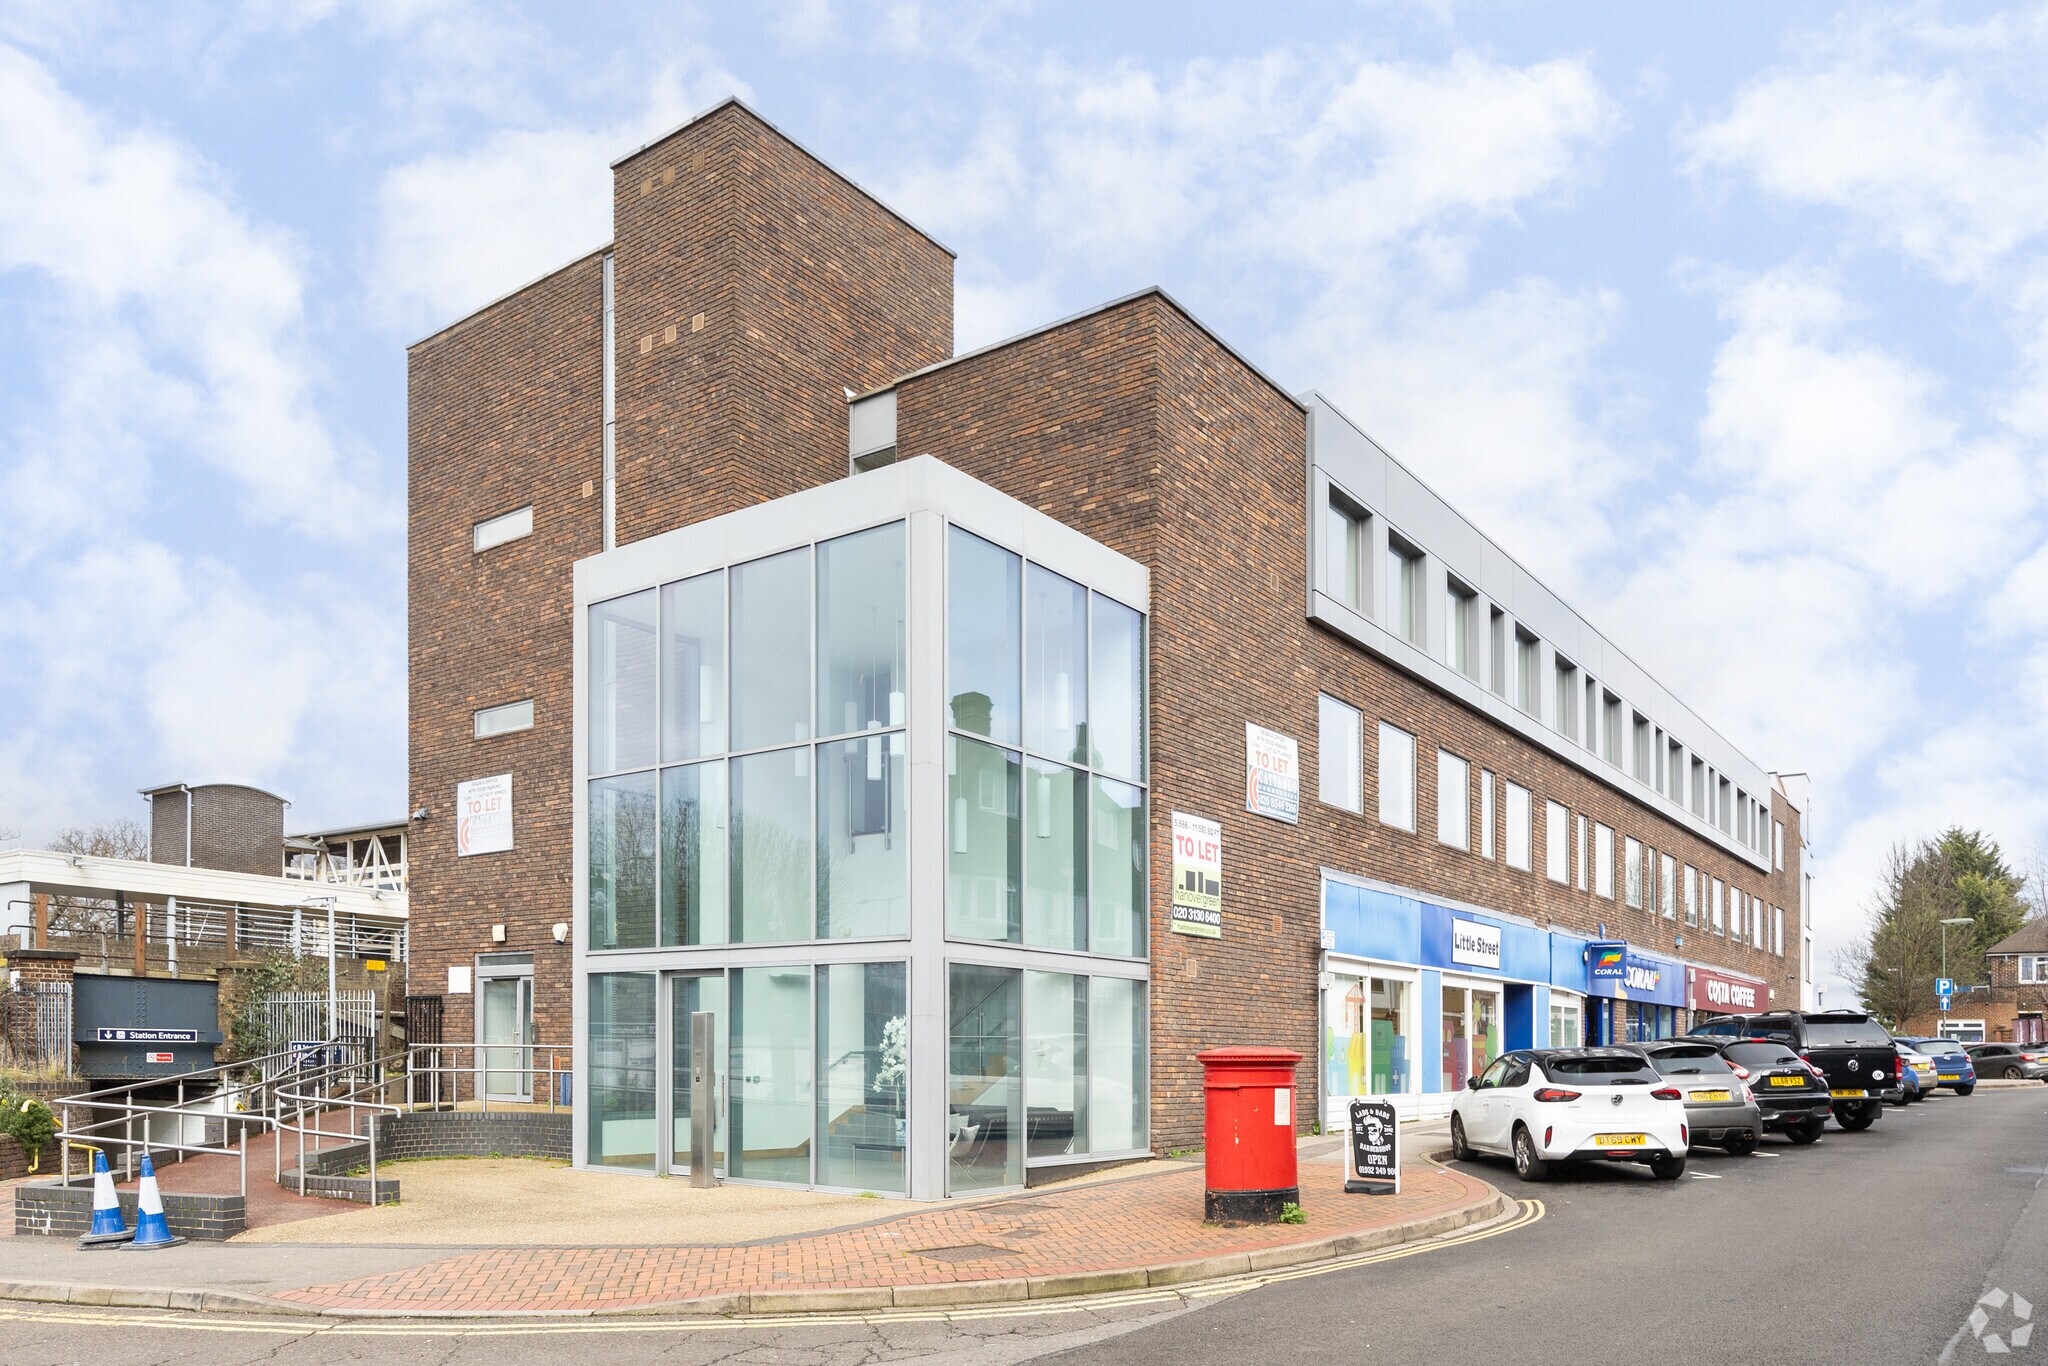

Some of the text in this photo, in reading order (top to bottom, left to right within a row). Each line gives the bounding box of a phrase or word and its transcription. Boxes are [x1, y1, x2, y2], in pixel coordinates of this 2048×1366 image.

[1256, 750, 1289, 774] TO LET
[467, 800, 481, 815] TO
[485, 797, 502, 812] LET
[1176, 834, 1218, 863] TO LET
[1175, 879, 1220, 908] hanovergreen
[1173, 905, 1220, 925] 020 3130 6400
[1454, 932, 1499, 956] Little Street
[1624, 966, 1656, 991] CORAL
[1939, 980, 1950, 994] P
[1707, 979, 1755, 1008] COSTA COFFEE
[129, 1031, 191, 1040] Station Entrance
[1355, 1108, 1370, 1119] LADS
[1375, 1109, 1391, 1120] DADS
[1599, 1135, 1642, 1145] DT69 CWY
[1367, 1154, 1388, 1165] OPEN
[1358, 1166, 1375, 1175] 01932
[1375, 1166, 1386, 1175] 349
